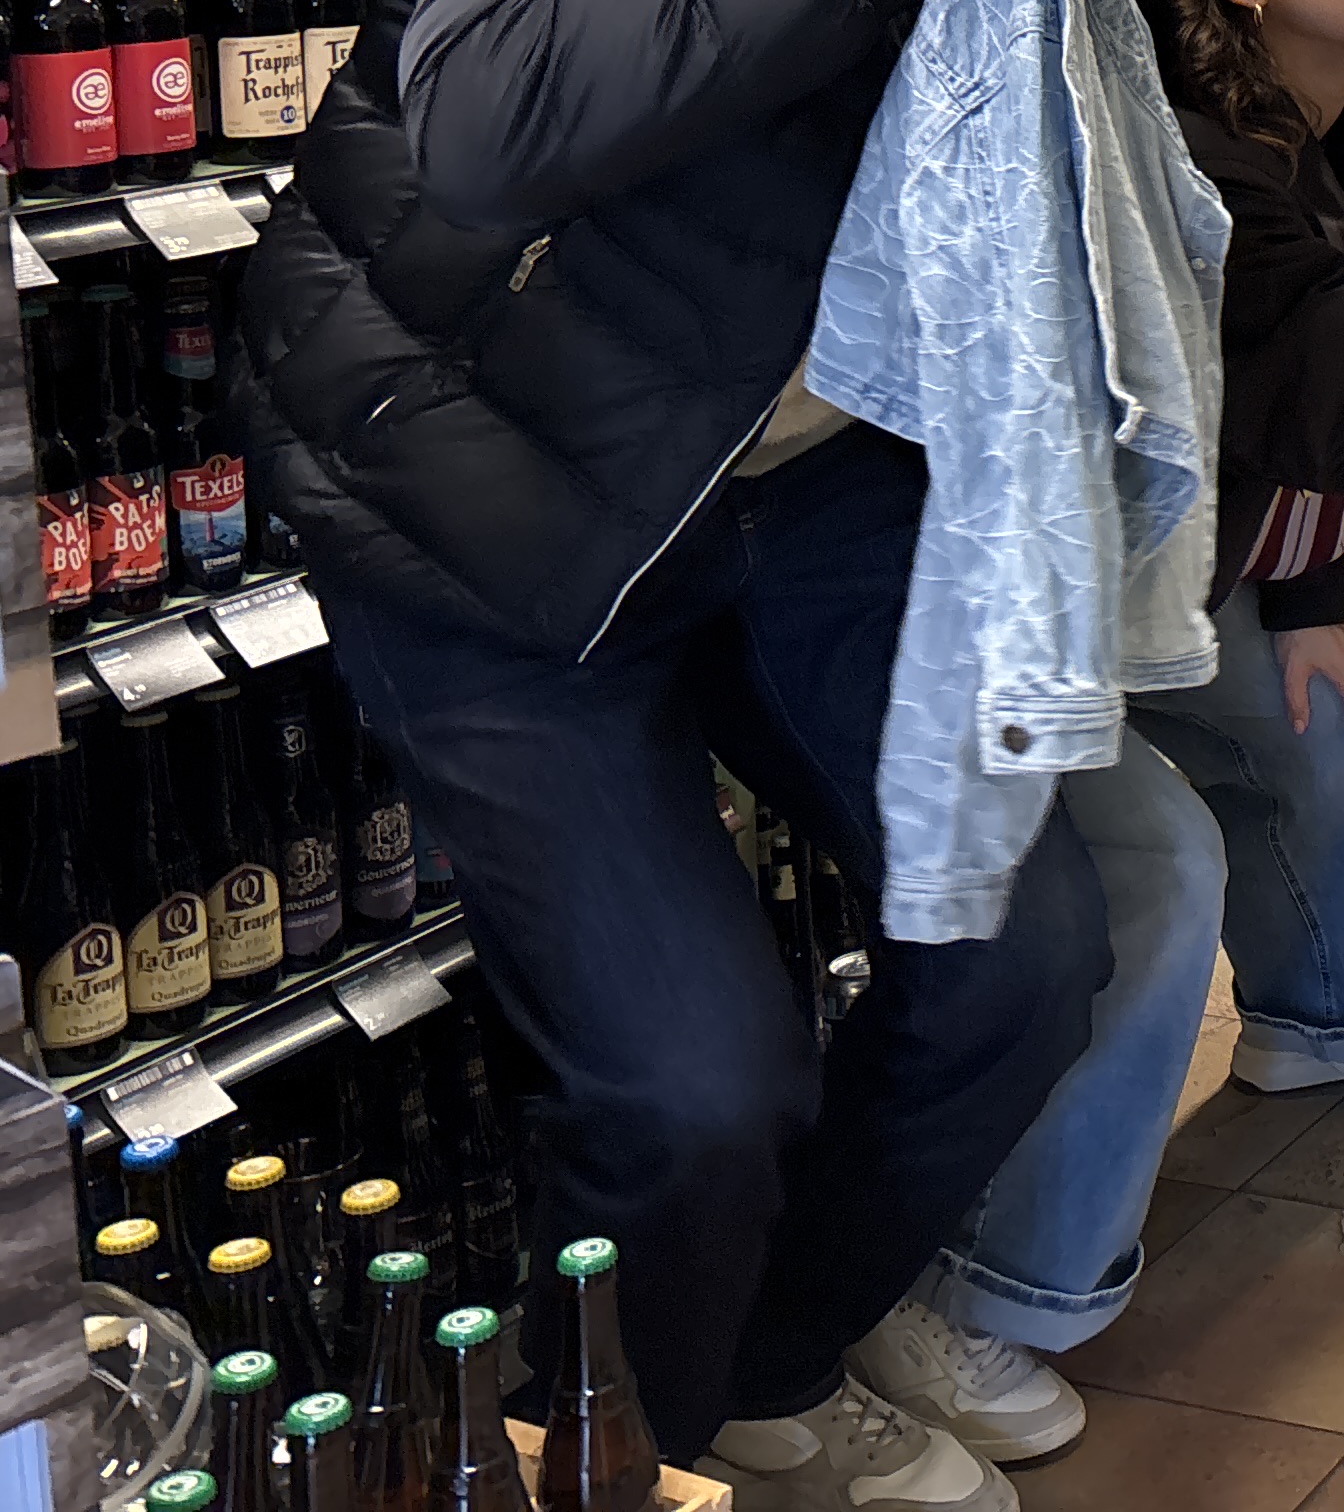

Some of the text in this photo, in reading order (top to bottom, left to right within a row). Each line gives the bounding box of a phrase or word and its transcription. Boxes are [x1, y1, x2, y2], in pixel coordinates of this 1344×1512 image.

[282, 108, 296, 121] 10
[176, 471, 245, 502] TEXELS
[108, 485, 161, 526] PATS
[134, 949, 159, 973] La
